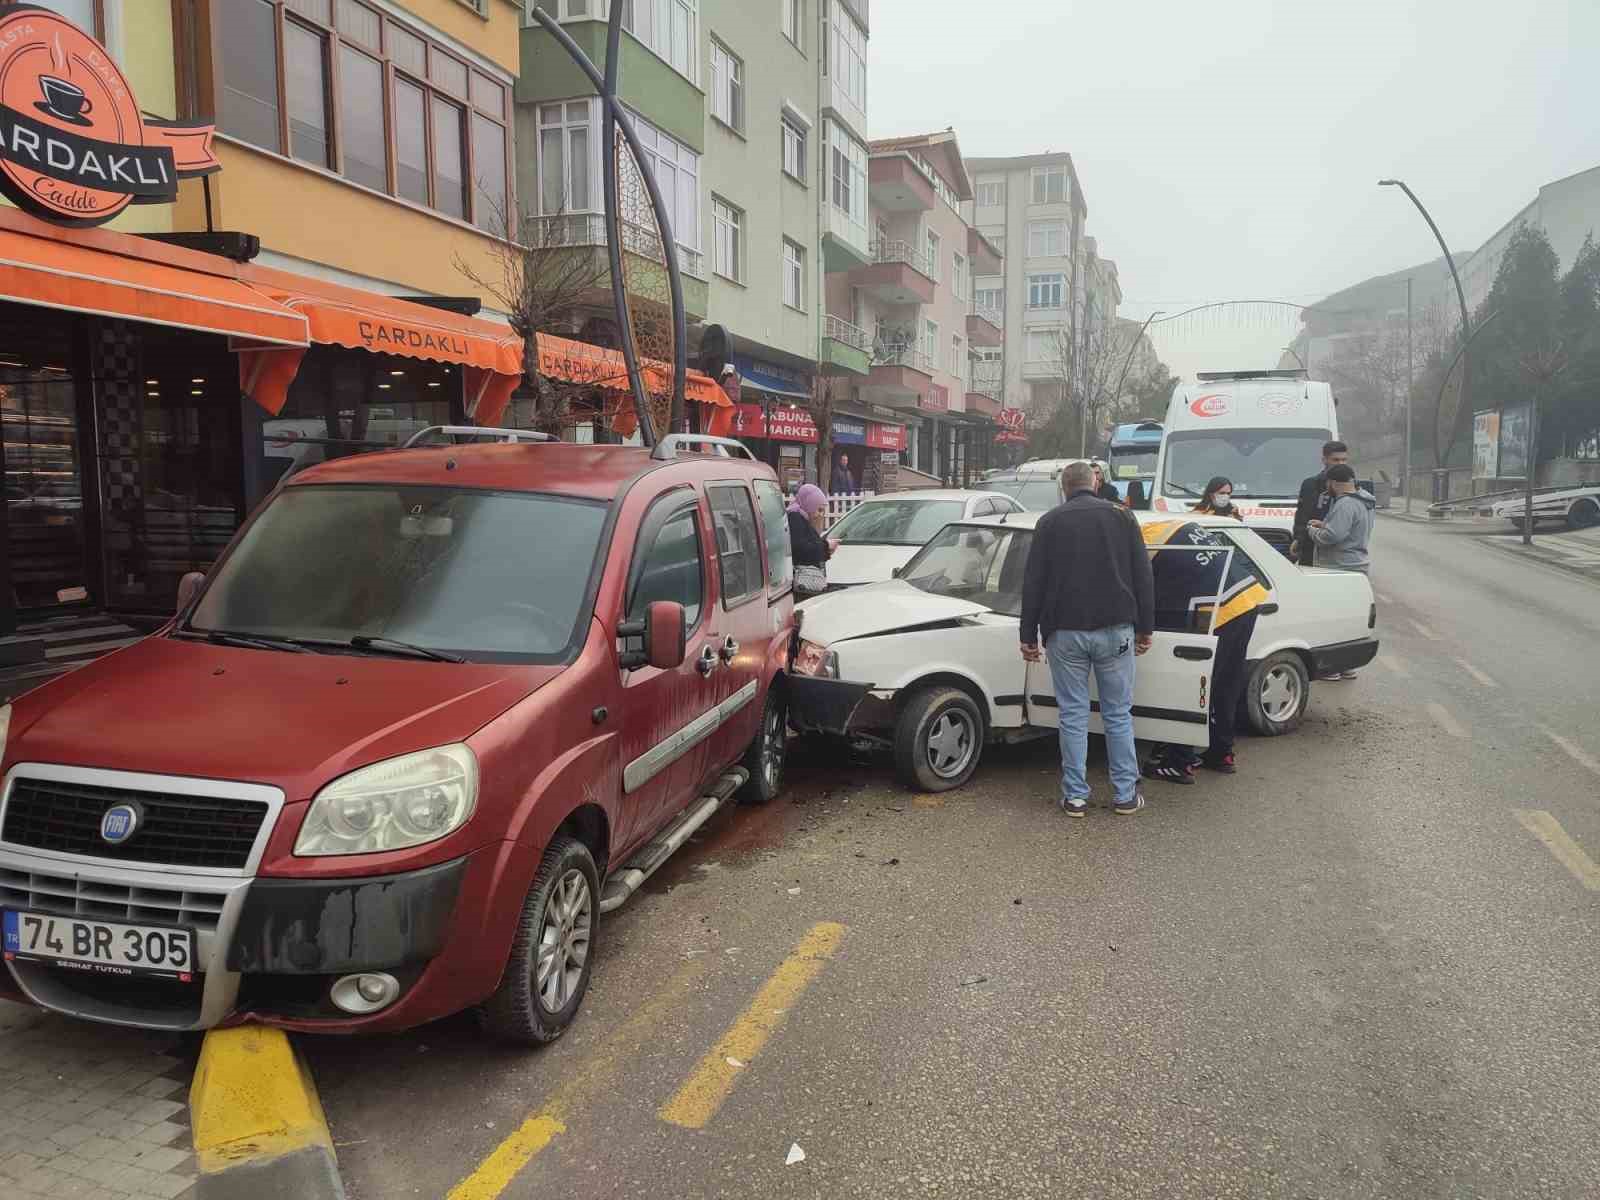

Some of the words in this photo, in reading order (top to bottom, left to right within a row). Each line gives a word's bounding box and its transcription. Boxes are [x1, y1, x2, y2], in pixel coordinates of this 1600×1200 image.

[0, 124, 169, 184] RDAKLI
[33, 177, 97, 209] Cadde
[358, 321, 470, 355] ÇARDAKLI
[763, 423, 818, 437] MARKET
[105, 814, 129, 834] FIAT
[7, 933, 18, 944] TR
[24, 917, 64, 953] 74
[72, 923, 113, 960] BR
[123, 929, 188, 967] 305
[56, 961, 92, 970] SERHAT
[95, 965, 132, 975] TUTKUN
